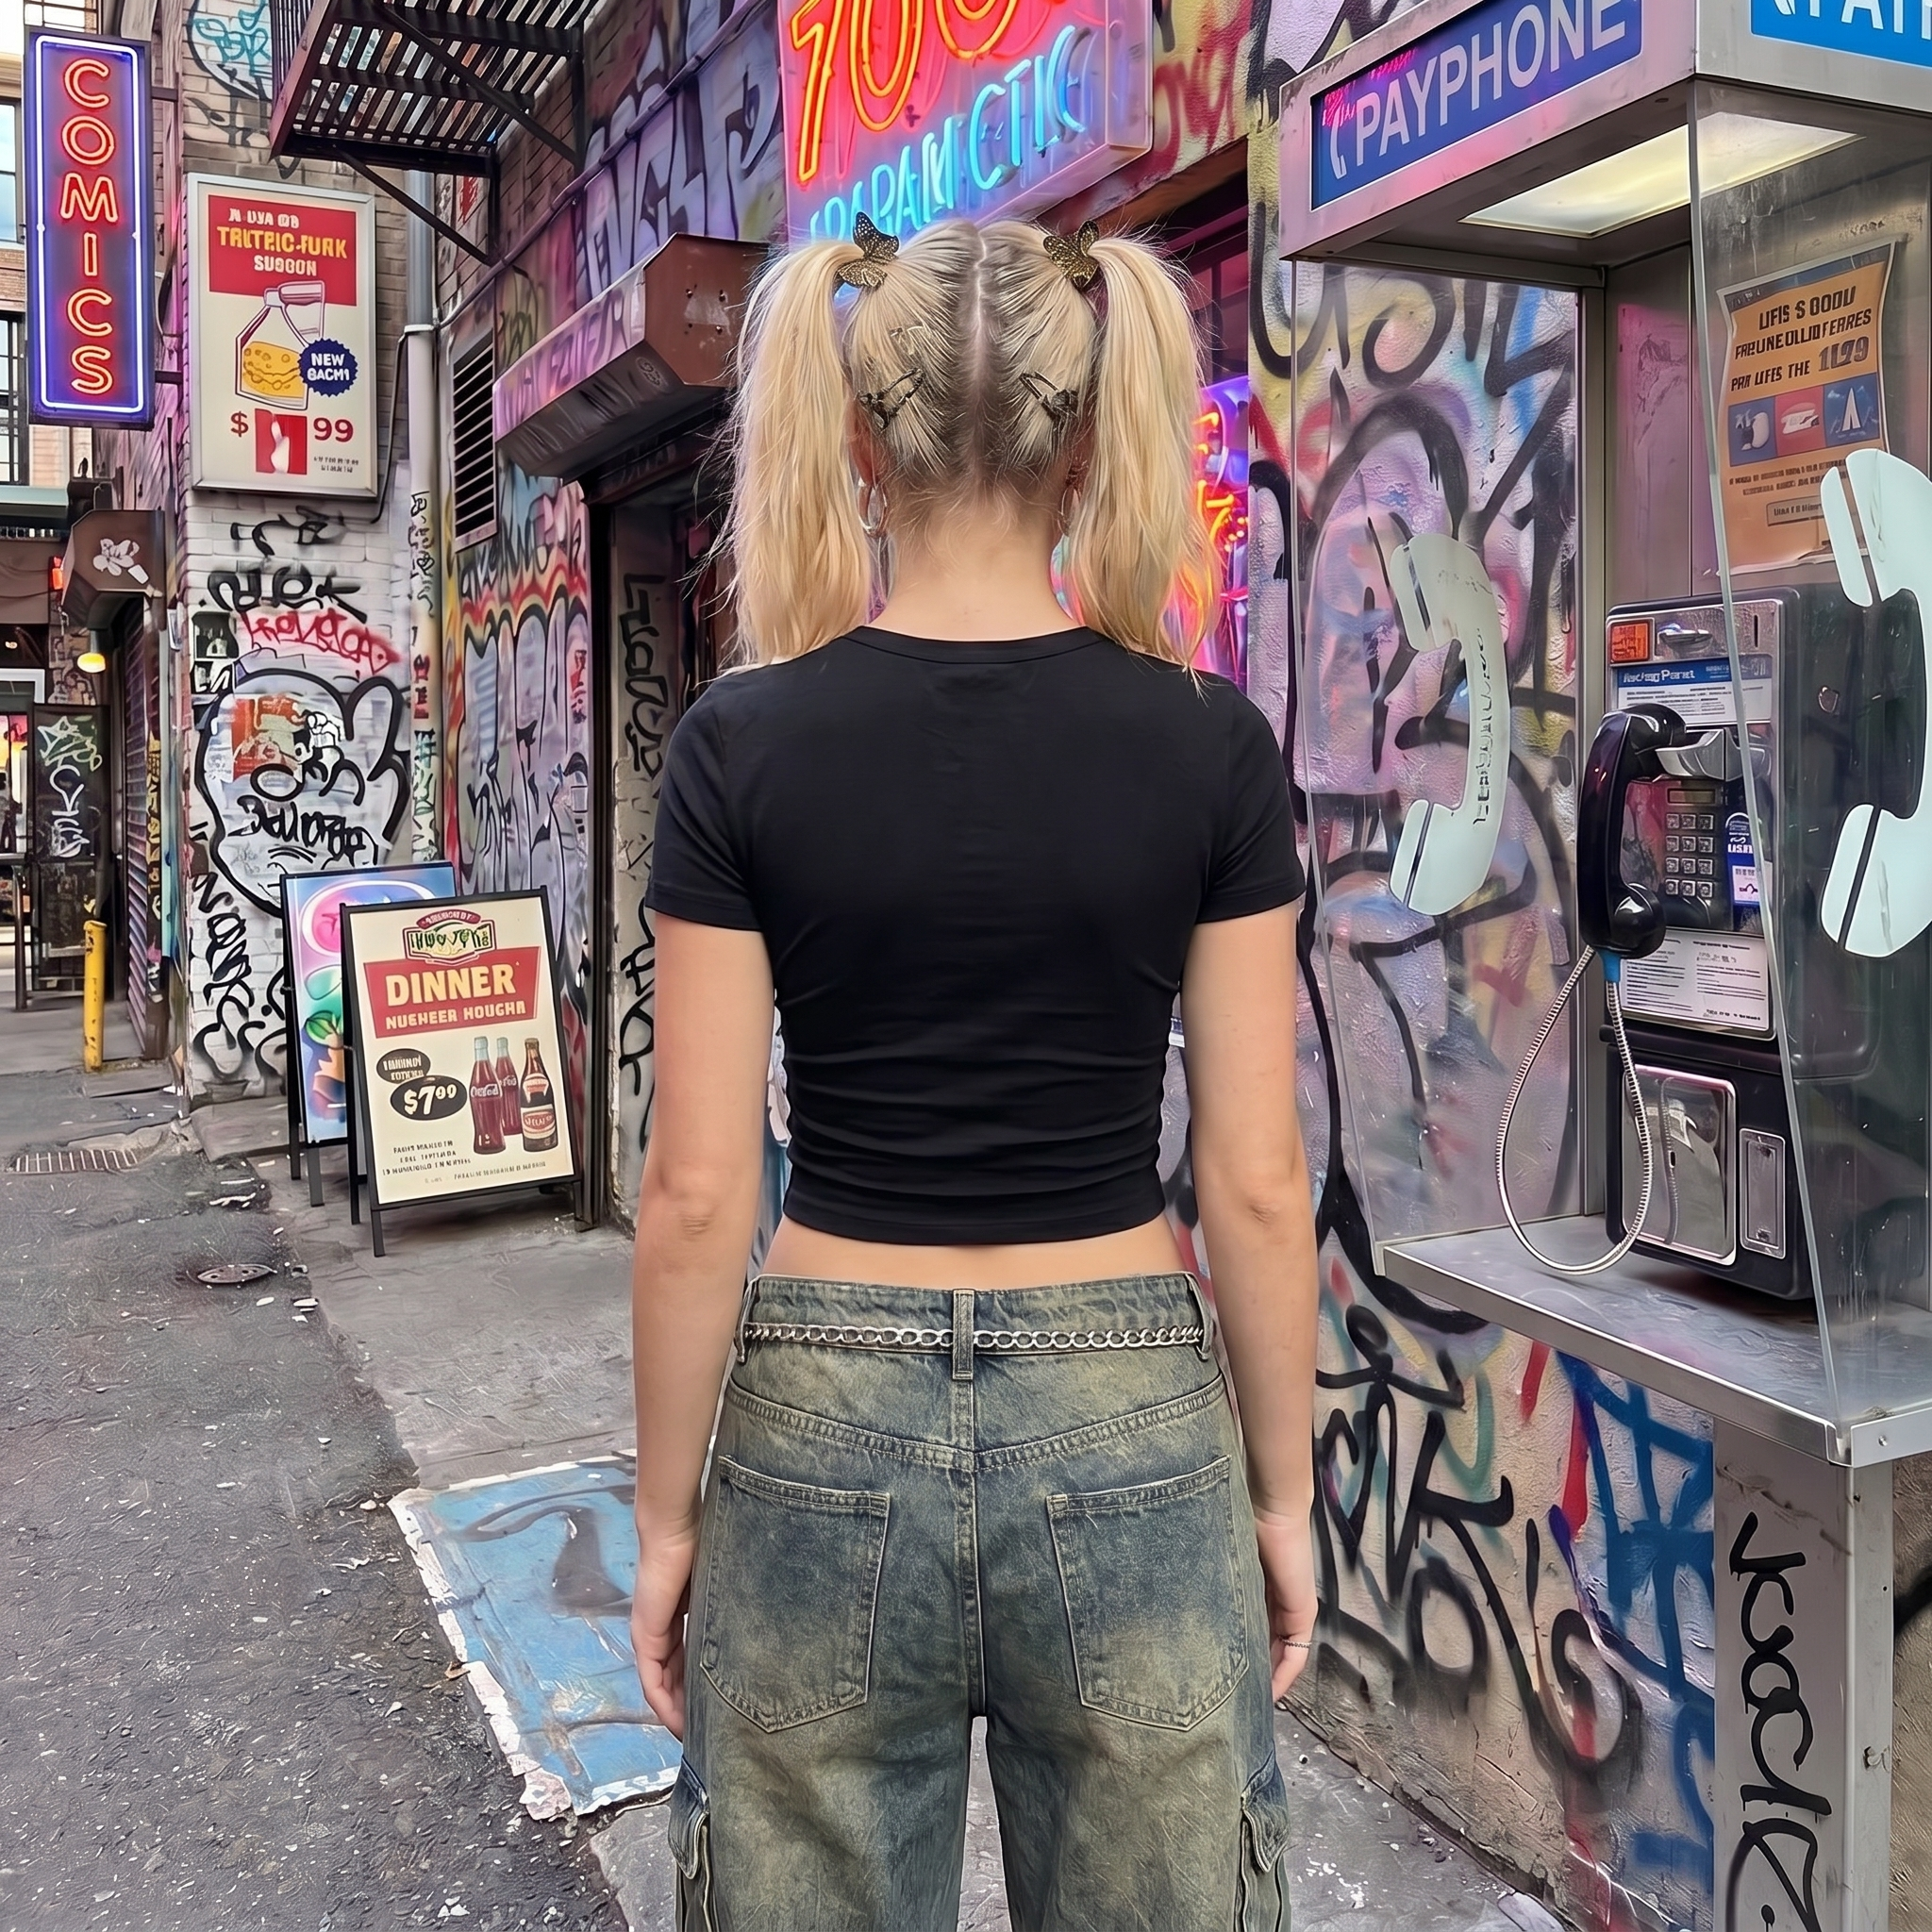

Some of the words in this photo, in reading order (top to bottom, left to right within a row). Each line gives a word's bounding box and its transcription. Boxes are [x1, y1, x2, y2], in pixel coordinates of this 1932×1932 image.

[1356, 0, 1626, 167] PAYPHONE
[60, 58, 119, 395] COMICS
[310, 353, 345, 366] NEW
[1788, 359, 1811, 378] THE
[312, 417, 355, 442] 99
[385, 963, 517, 1008] DINNER
